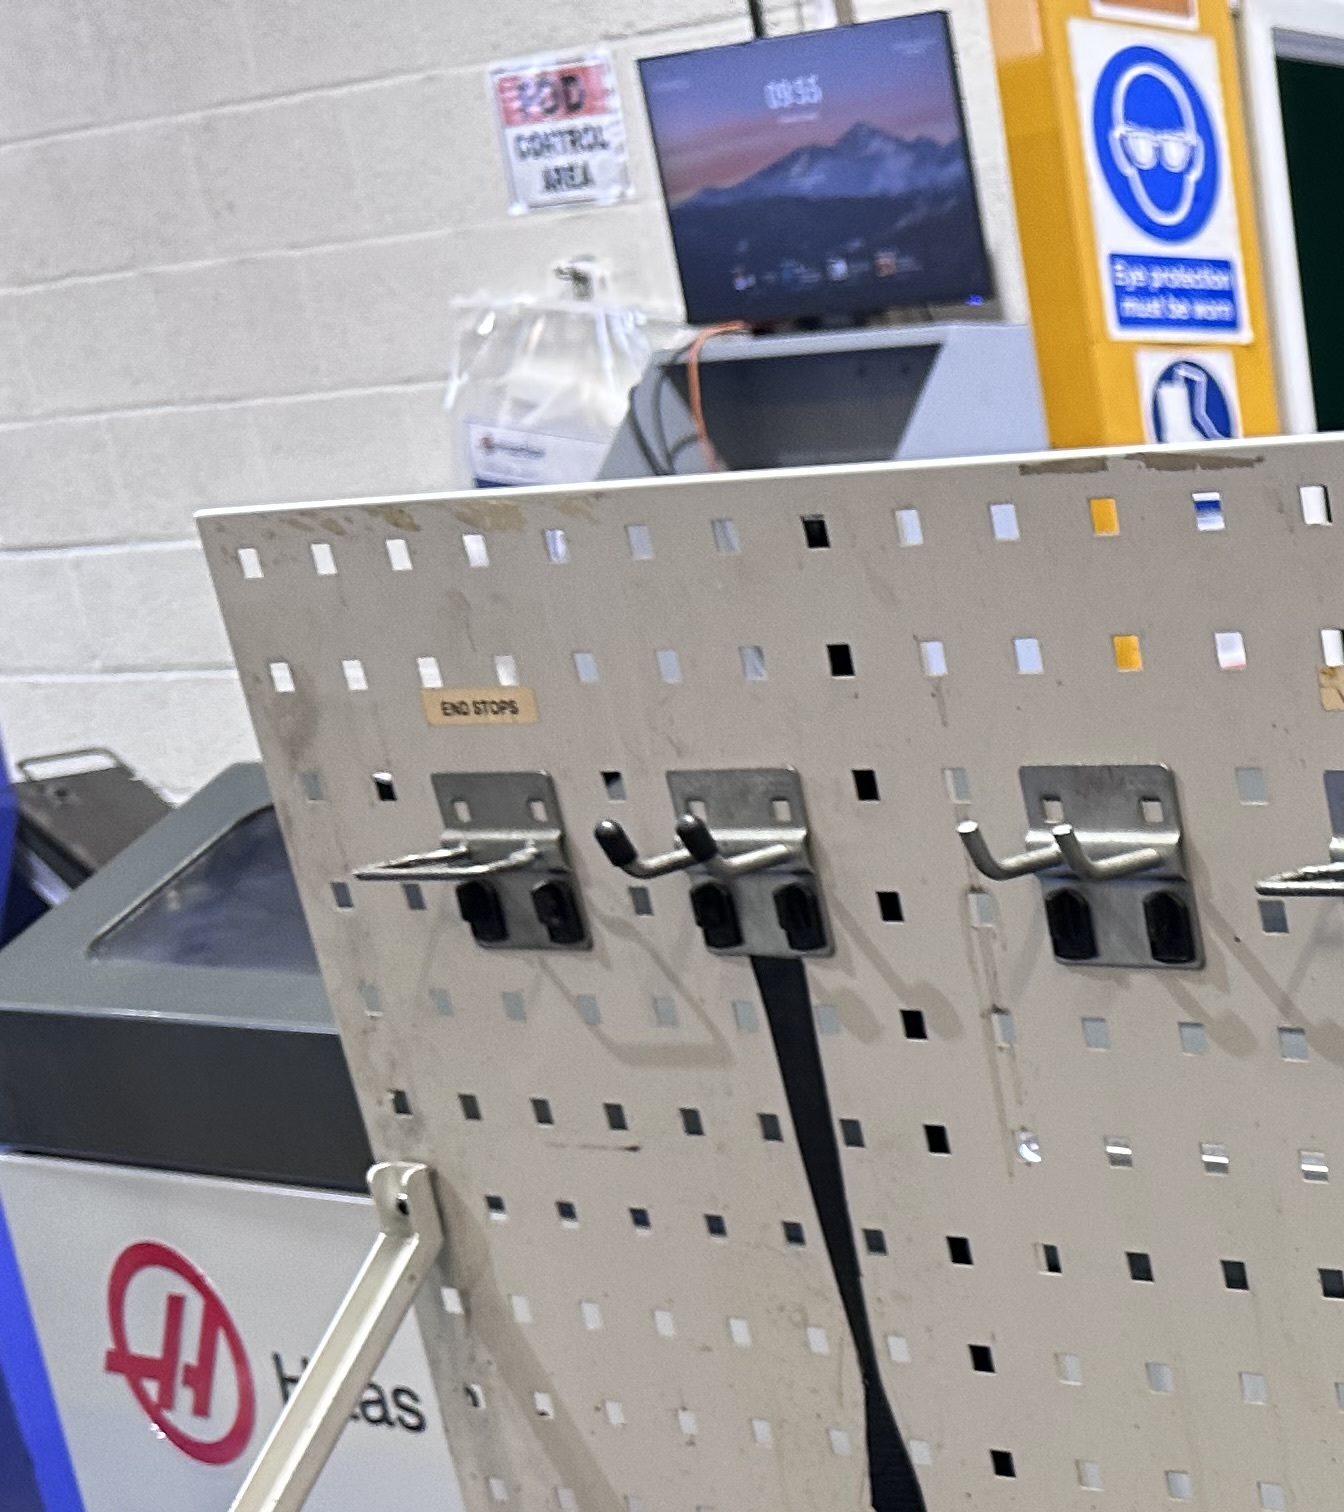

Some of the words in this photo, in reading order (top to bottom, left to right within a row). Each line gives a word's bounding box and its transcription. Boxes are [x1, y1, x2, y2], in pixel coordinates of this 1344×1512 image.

[514, 124, 609, 160] CONTROL
[1113, 260, 1148, 291] Eye
[1150, 265, 1231, 292] protection
[1121, 296, 1162, 319] must
[1167, 295, 1190, 320] be
[1193, 301, 1232, 321] worn
[441, 700, 470, 716] END
[472, 699, 519, 716] STOPS
[272, 1351, 427, 1433] Has
